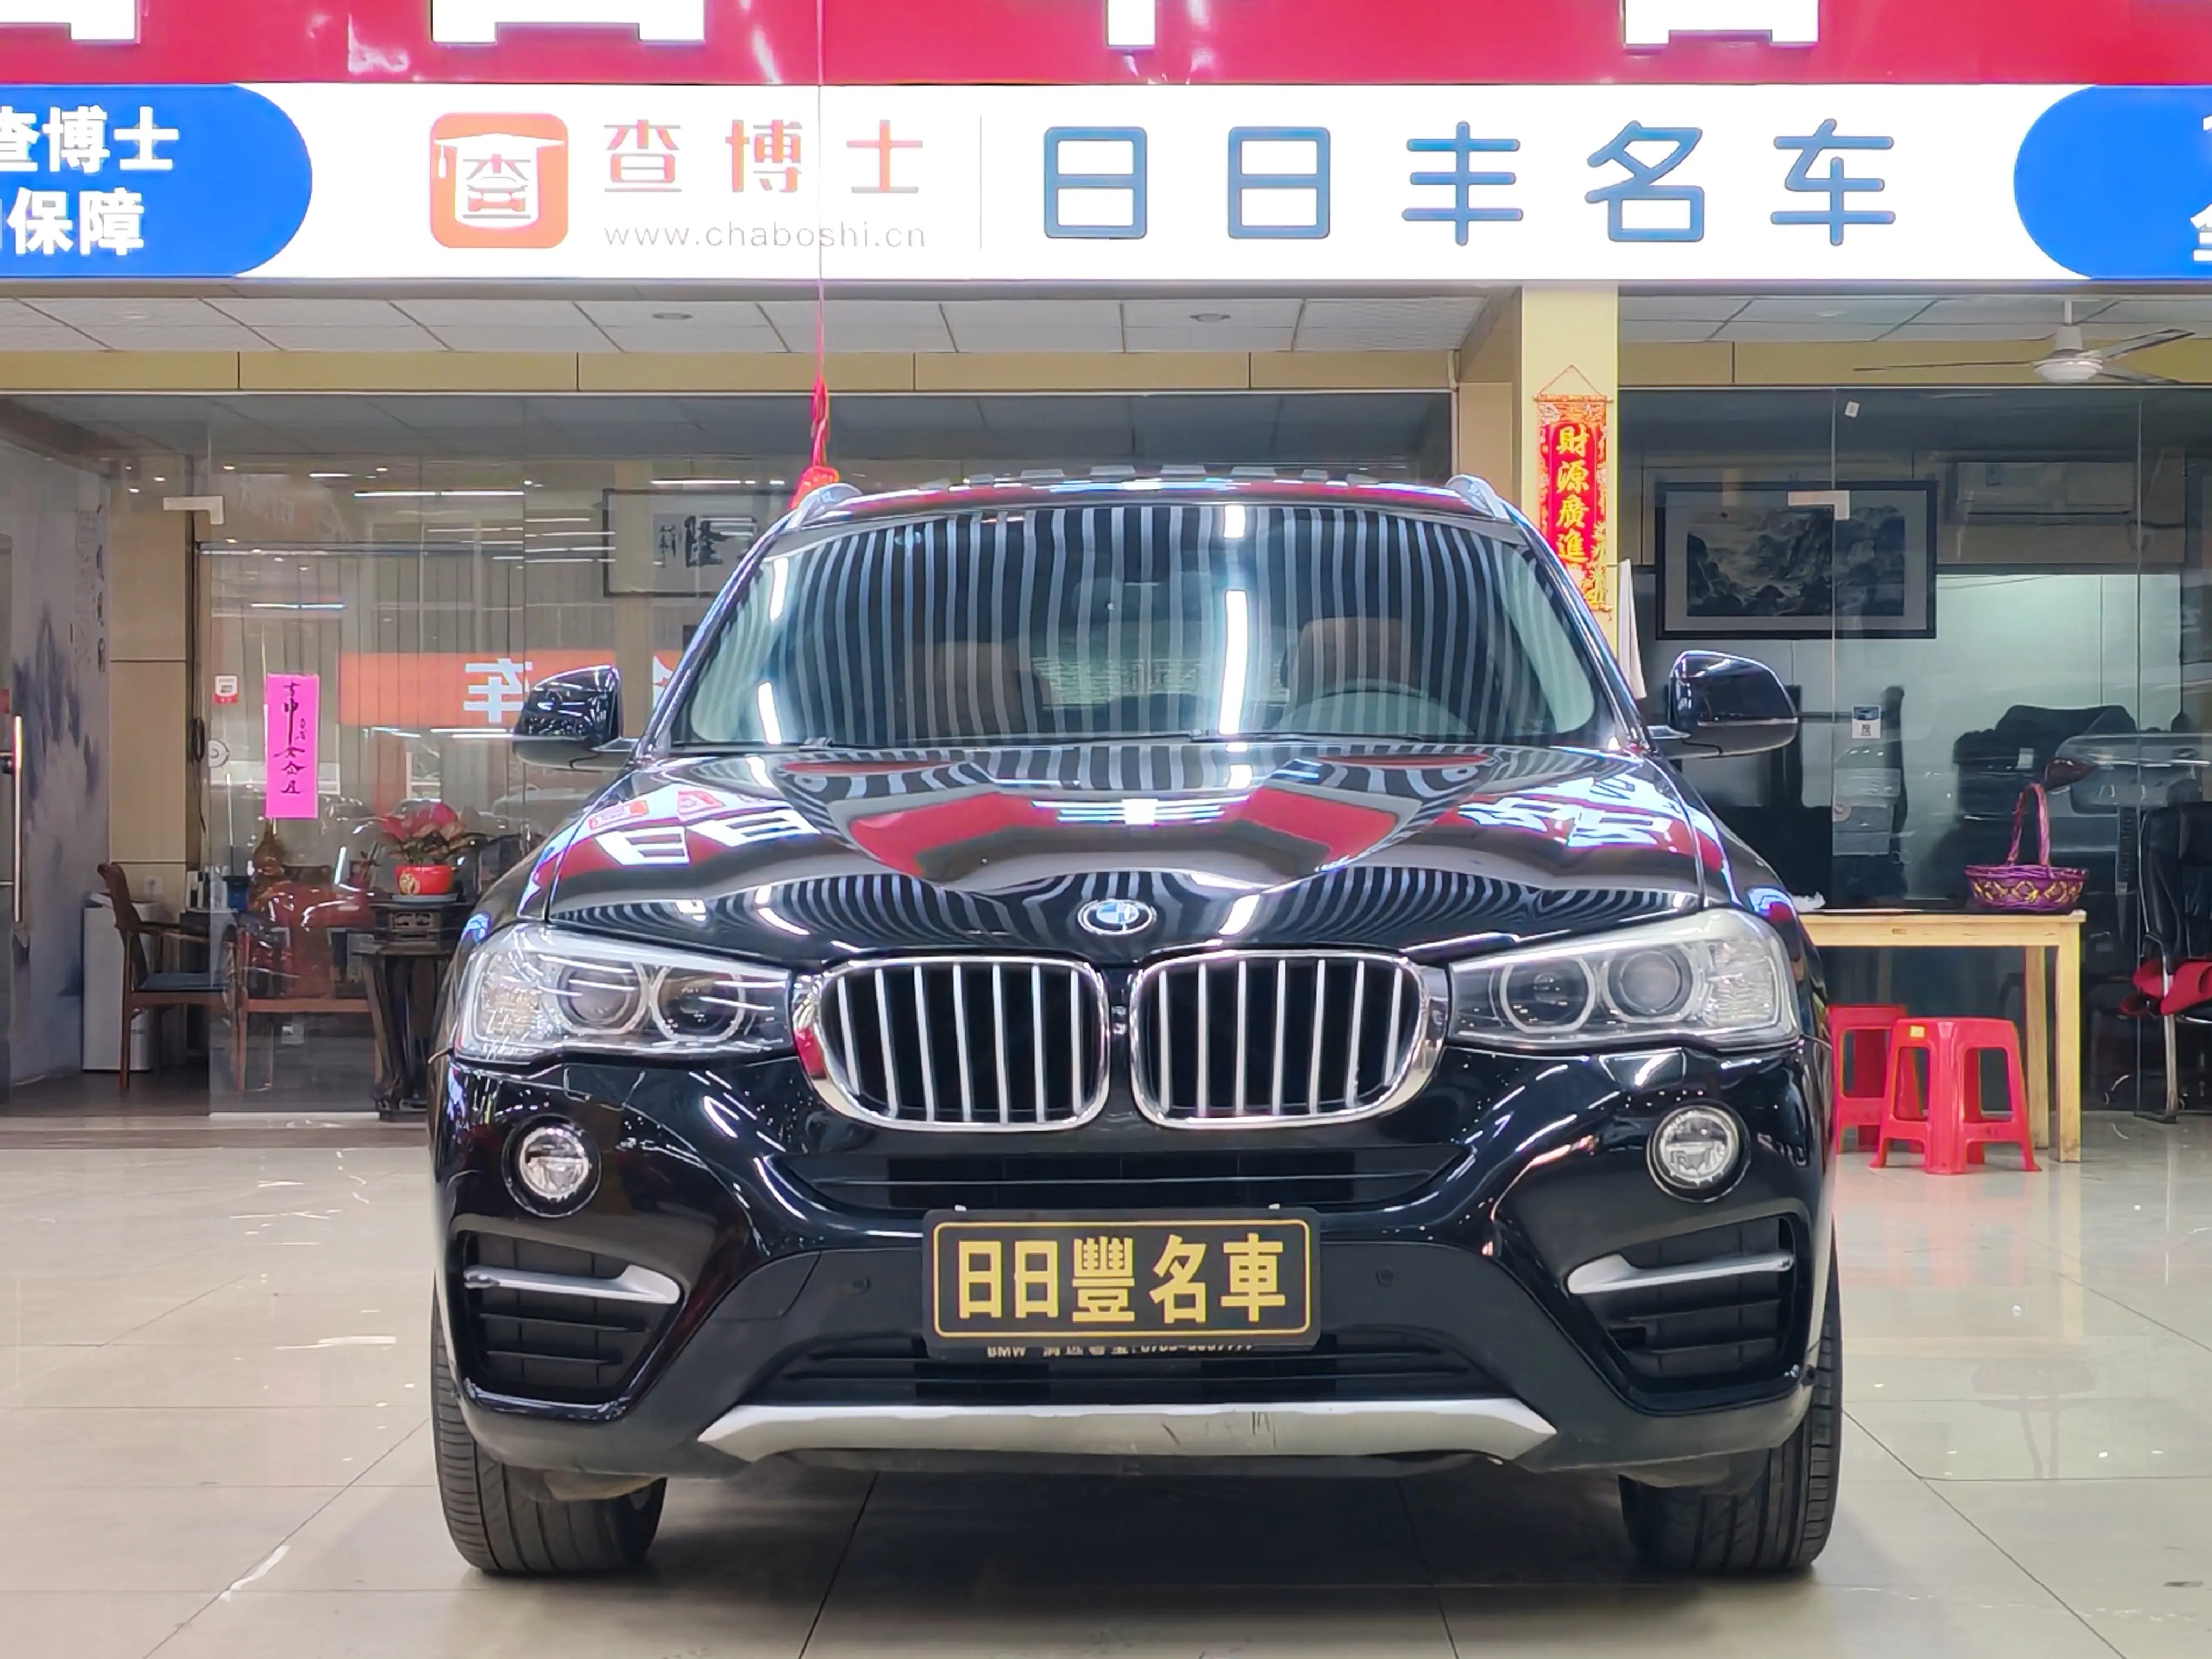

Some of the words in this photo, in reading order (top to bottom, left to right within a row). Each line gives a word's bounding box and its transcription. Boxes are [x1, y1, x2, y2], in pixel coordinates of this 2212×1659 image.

[0, 105, 179, 173] 查博士
[603, 119, 923, 194] 查博士
[1042, 118, 1897, 247] 日日丰名车
[0, 187, 144, 255] 保障
[604, 221, 925, 248] www.chaboshi.cn
[1555, 423, 1590, 563] 財源廣進
[958, 1233, 1286, 1323] 日日豐名車
